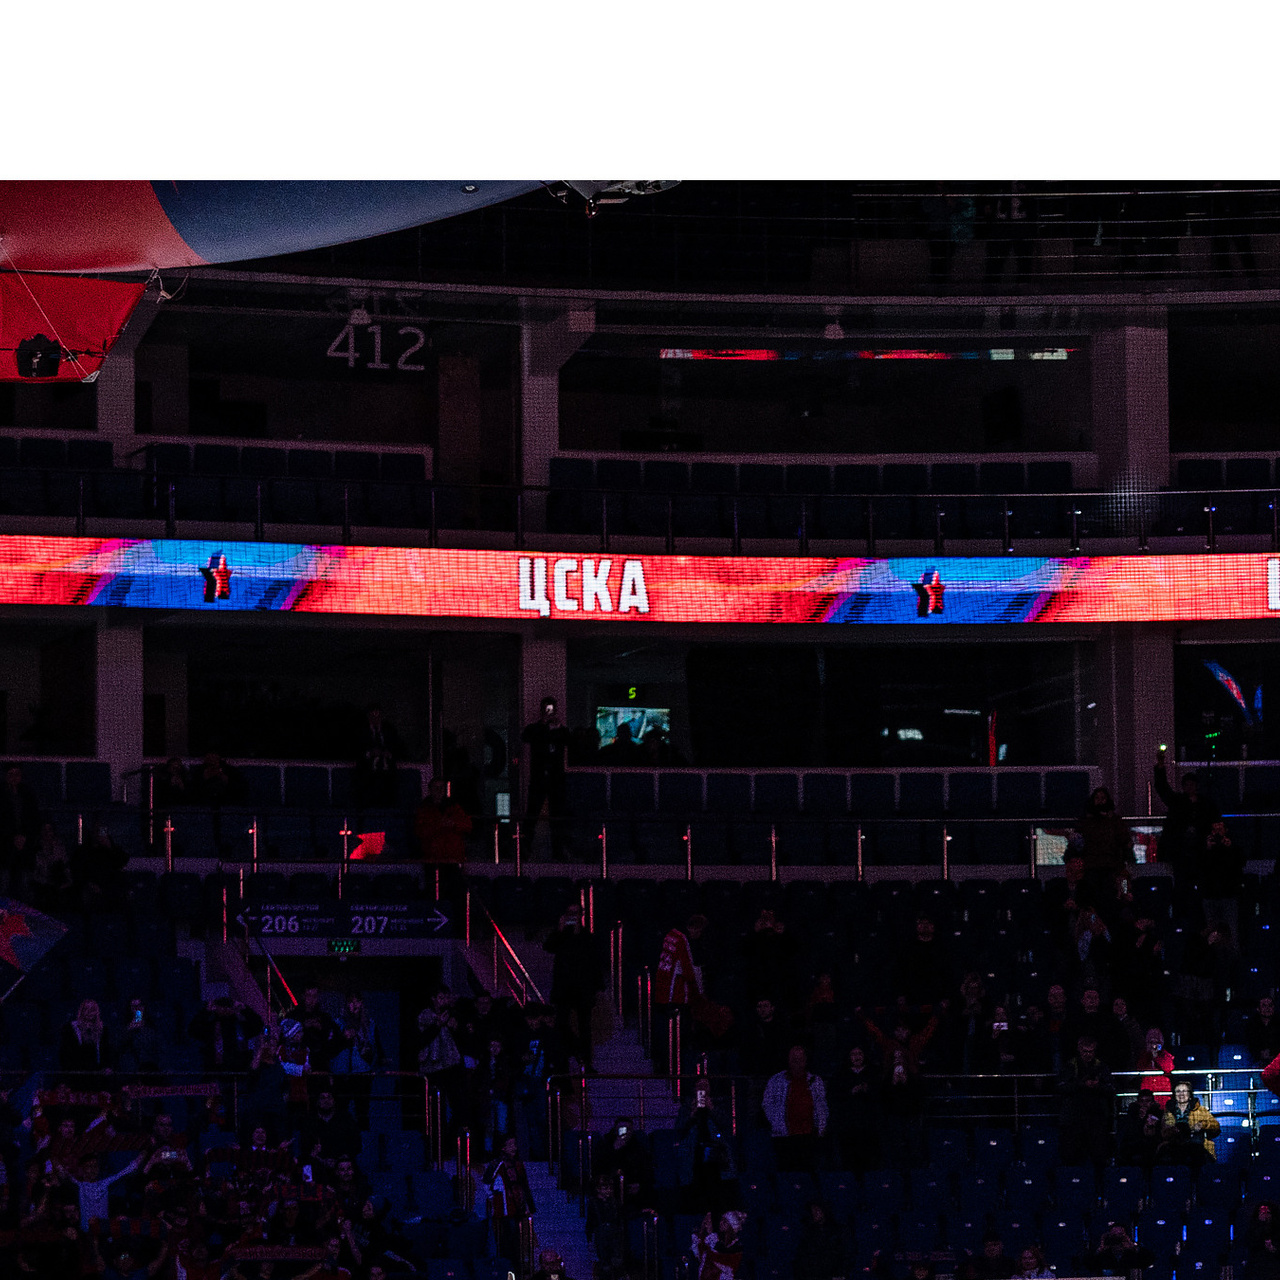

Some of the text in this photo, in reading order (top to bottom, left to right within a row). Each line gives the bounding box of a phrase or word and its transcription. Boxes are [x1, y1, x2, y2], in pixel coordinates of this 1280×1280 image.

[326, 324, 426, 371] 412
[518, 556, 650, 617] ЦСКА
[261, 915, 300, 933] 206
[351, 915, 389, 934] 207
